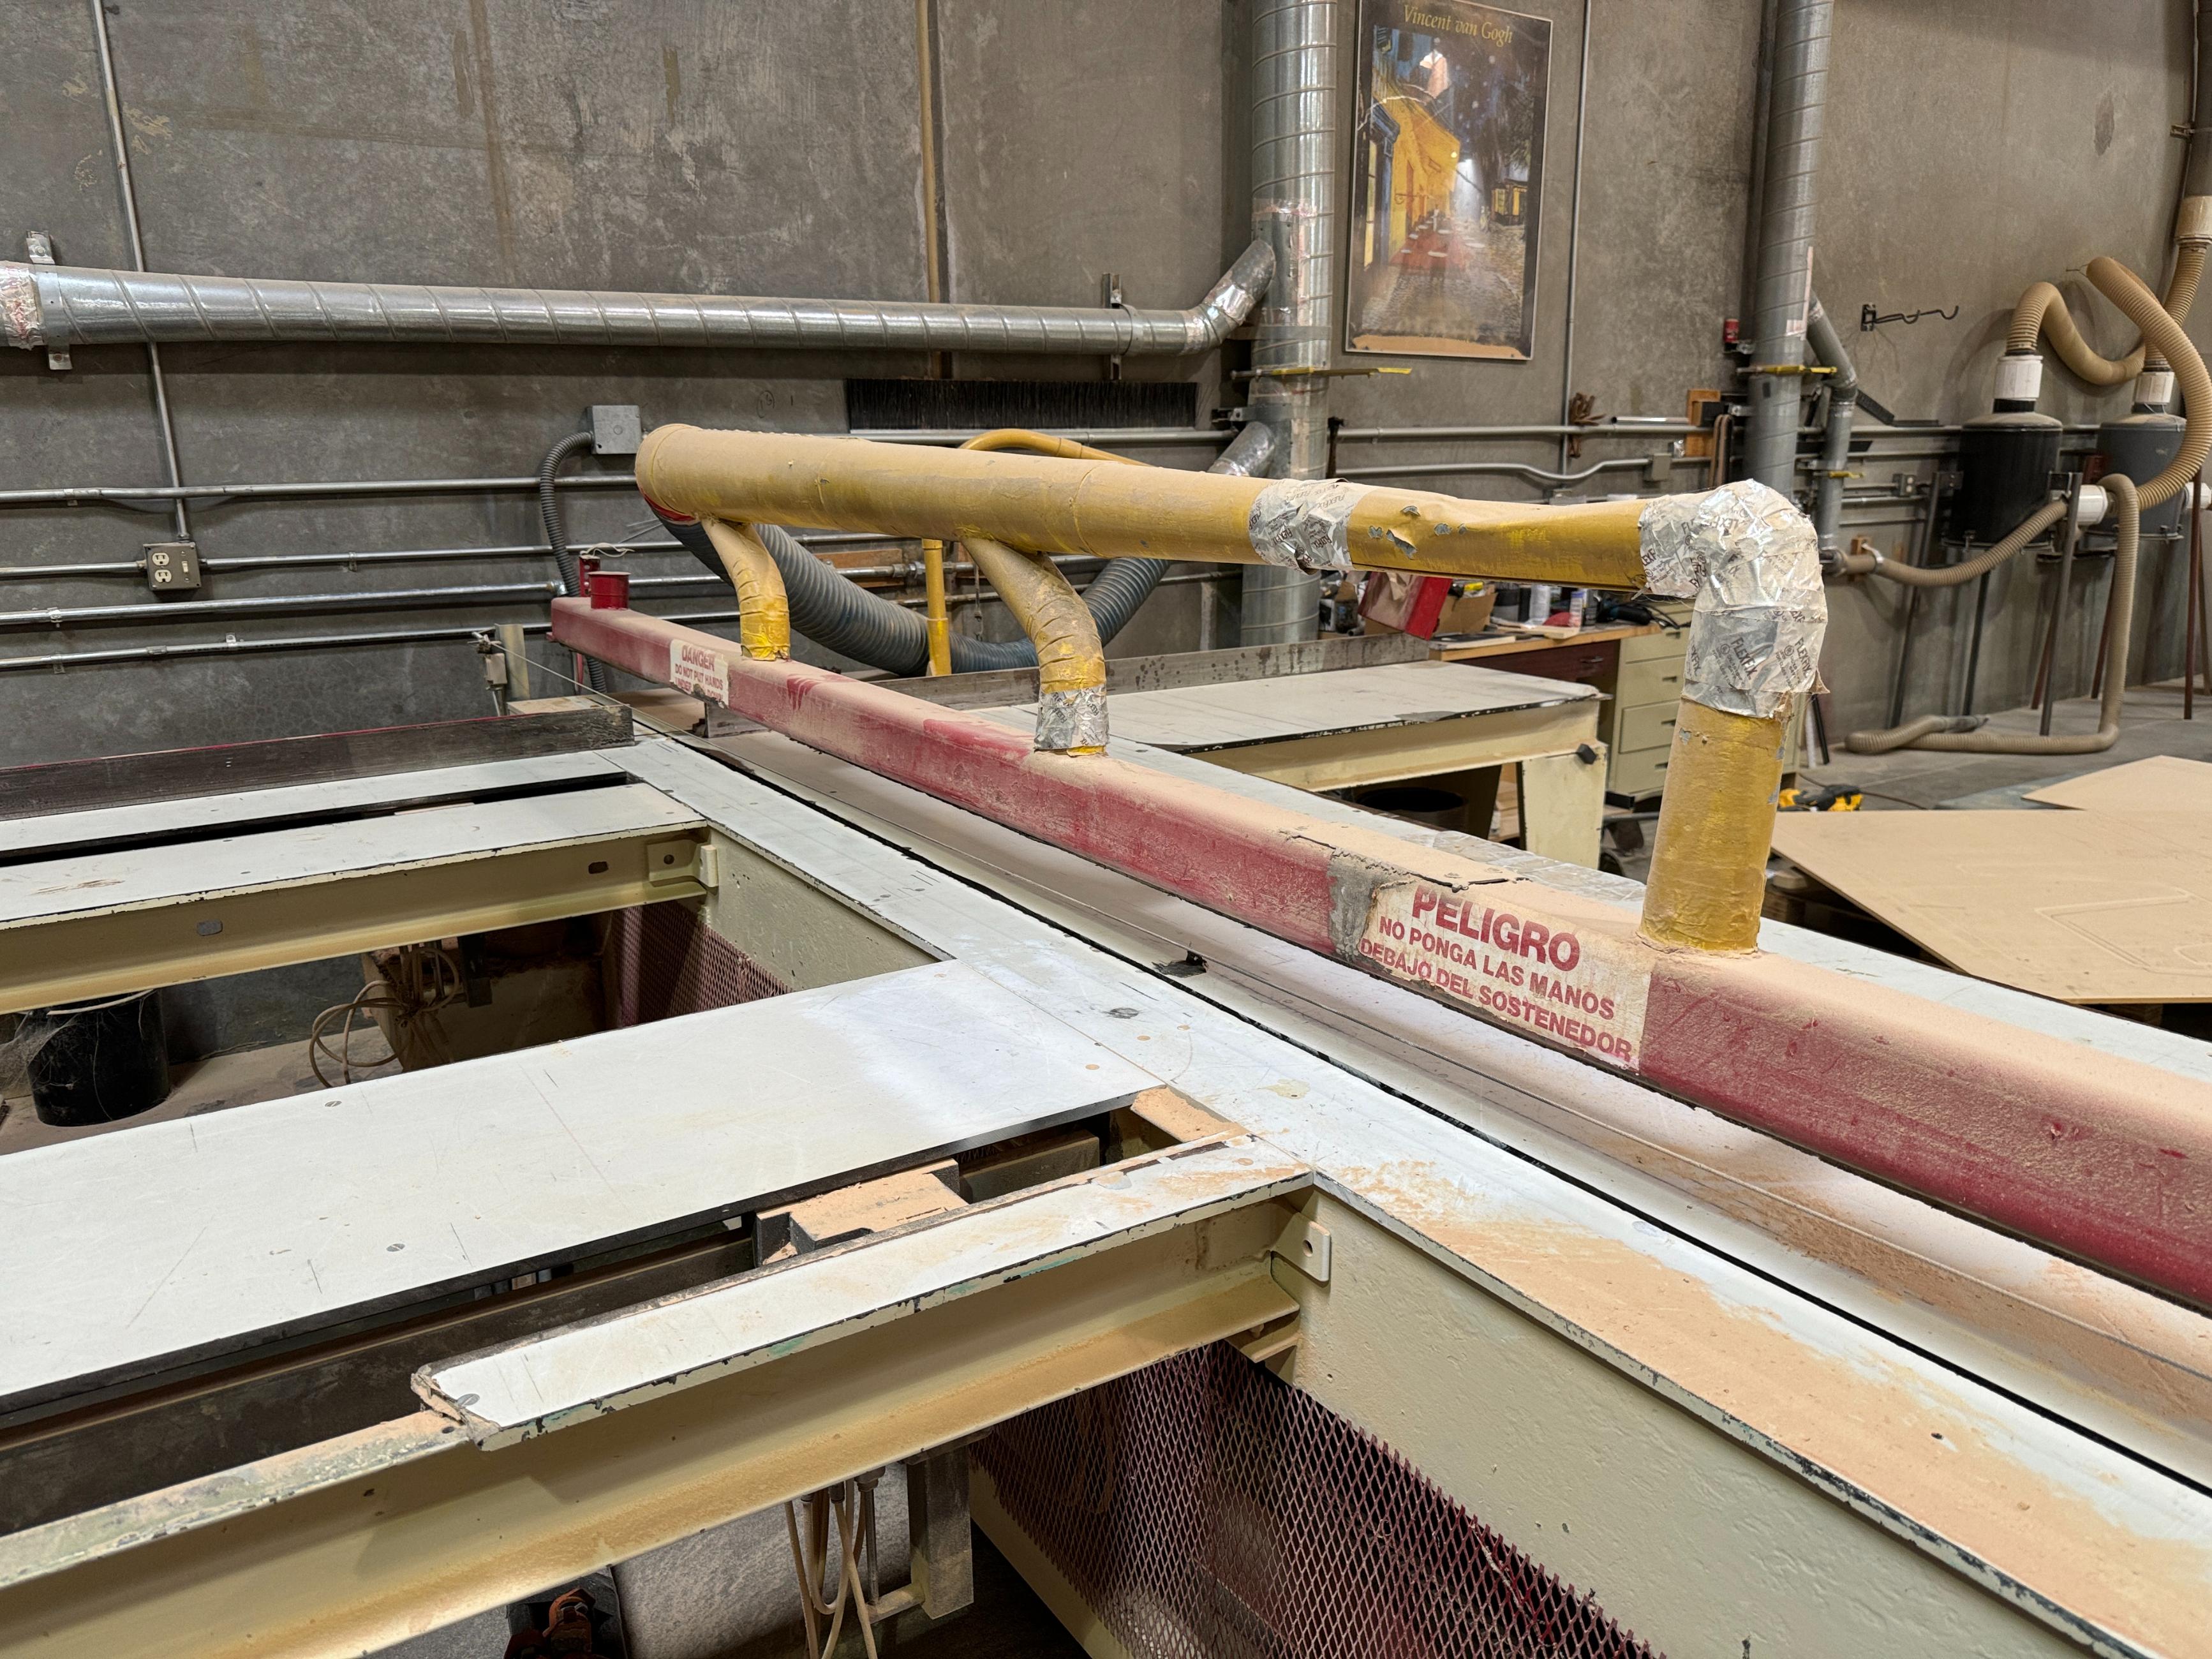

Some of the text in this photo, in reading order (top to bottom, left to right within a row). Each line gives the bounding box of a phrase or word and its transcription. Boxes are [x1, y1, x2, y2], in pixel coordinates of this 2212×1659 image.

[1404, 4, 1513, 47] Vincent van Gogh
[682, 644, 715, 671] DANGER
[1730, 637, 1758, 677] FLEXFIX
[1795, 637, 1812, 673] FLEXFIX
[675, 664, 723, 690] DO NOT PUT HANDS
[1412, 885, 1580, 972] PELIGRO
[1379, 916, 1615, 1020] NO PONGA LAS MANOS
[1360, 937, 1633, 1063] DEBAJO DEL SOSTENEDOR
